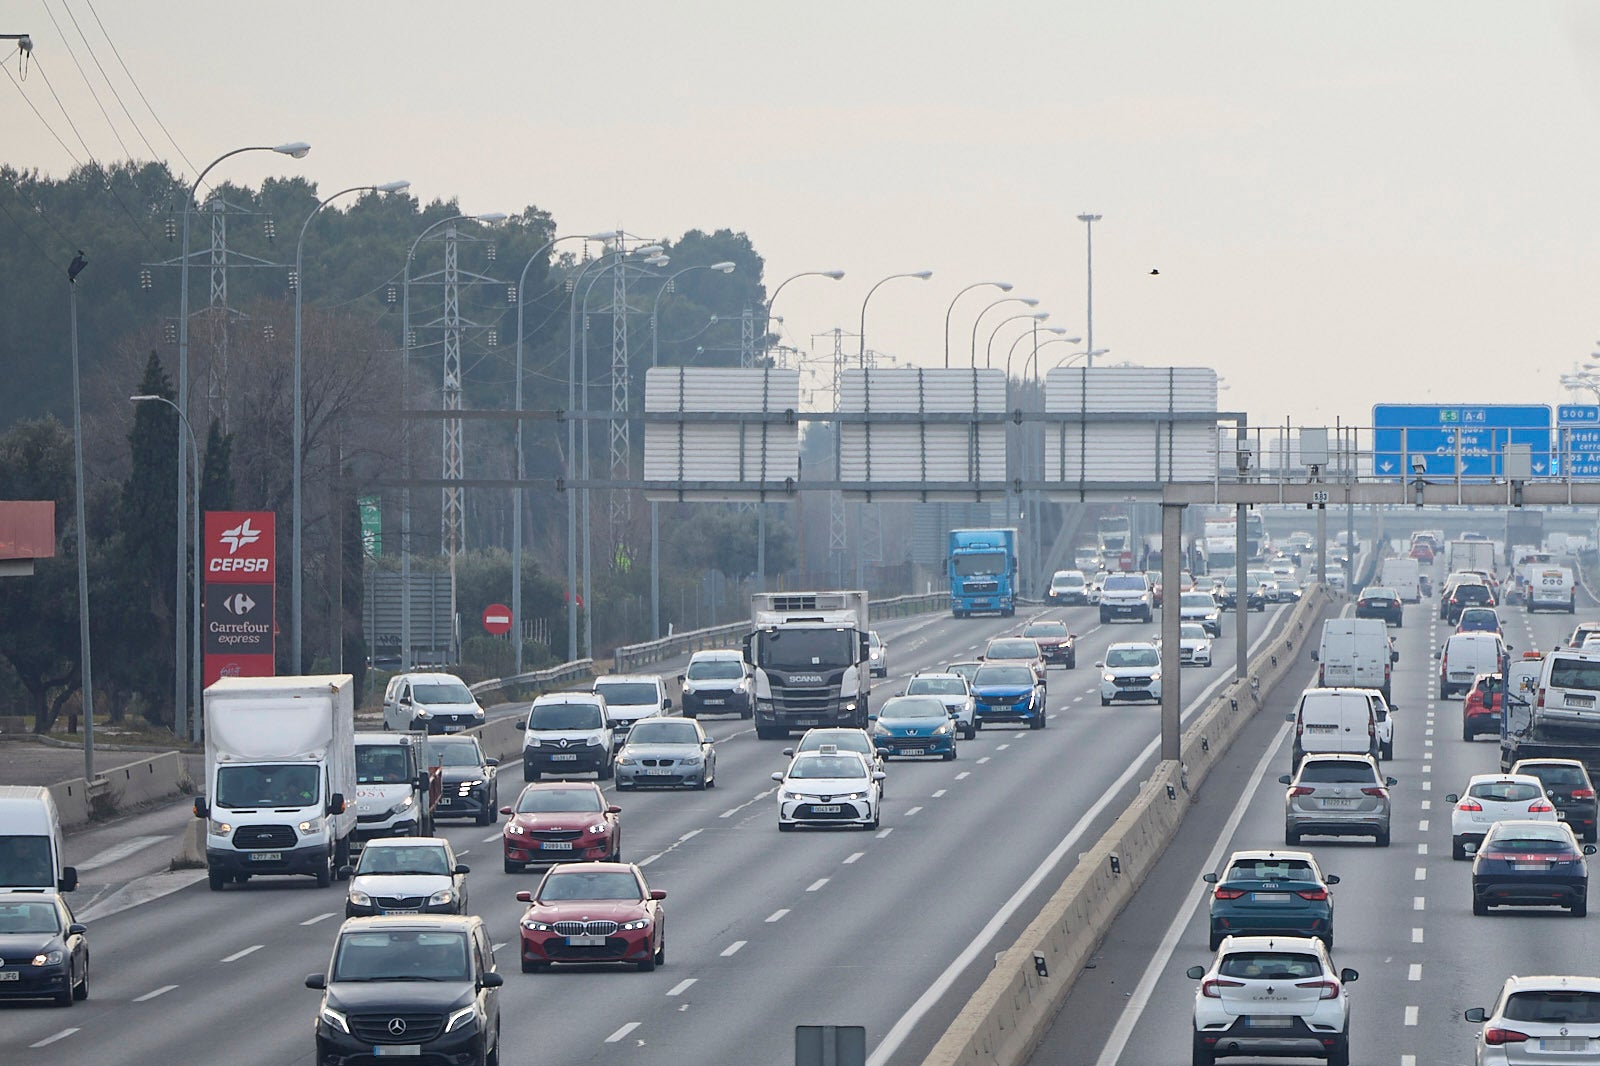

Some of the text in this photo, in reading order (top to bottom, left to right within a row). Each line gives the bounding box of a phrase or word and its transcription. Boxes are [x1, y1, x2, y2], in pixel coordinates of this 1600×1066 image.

[210, 558, 269, 572] CEPSA
[210, 621, 269, 633] Carrefour
[218, 633, 260, 644] express
